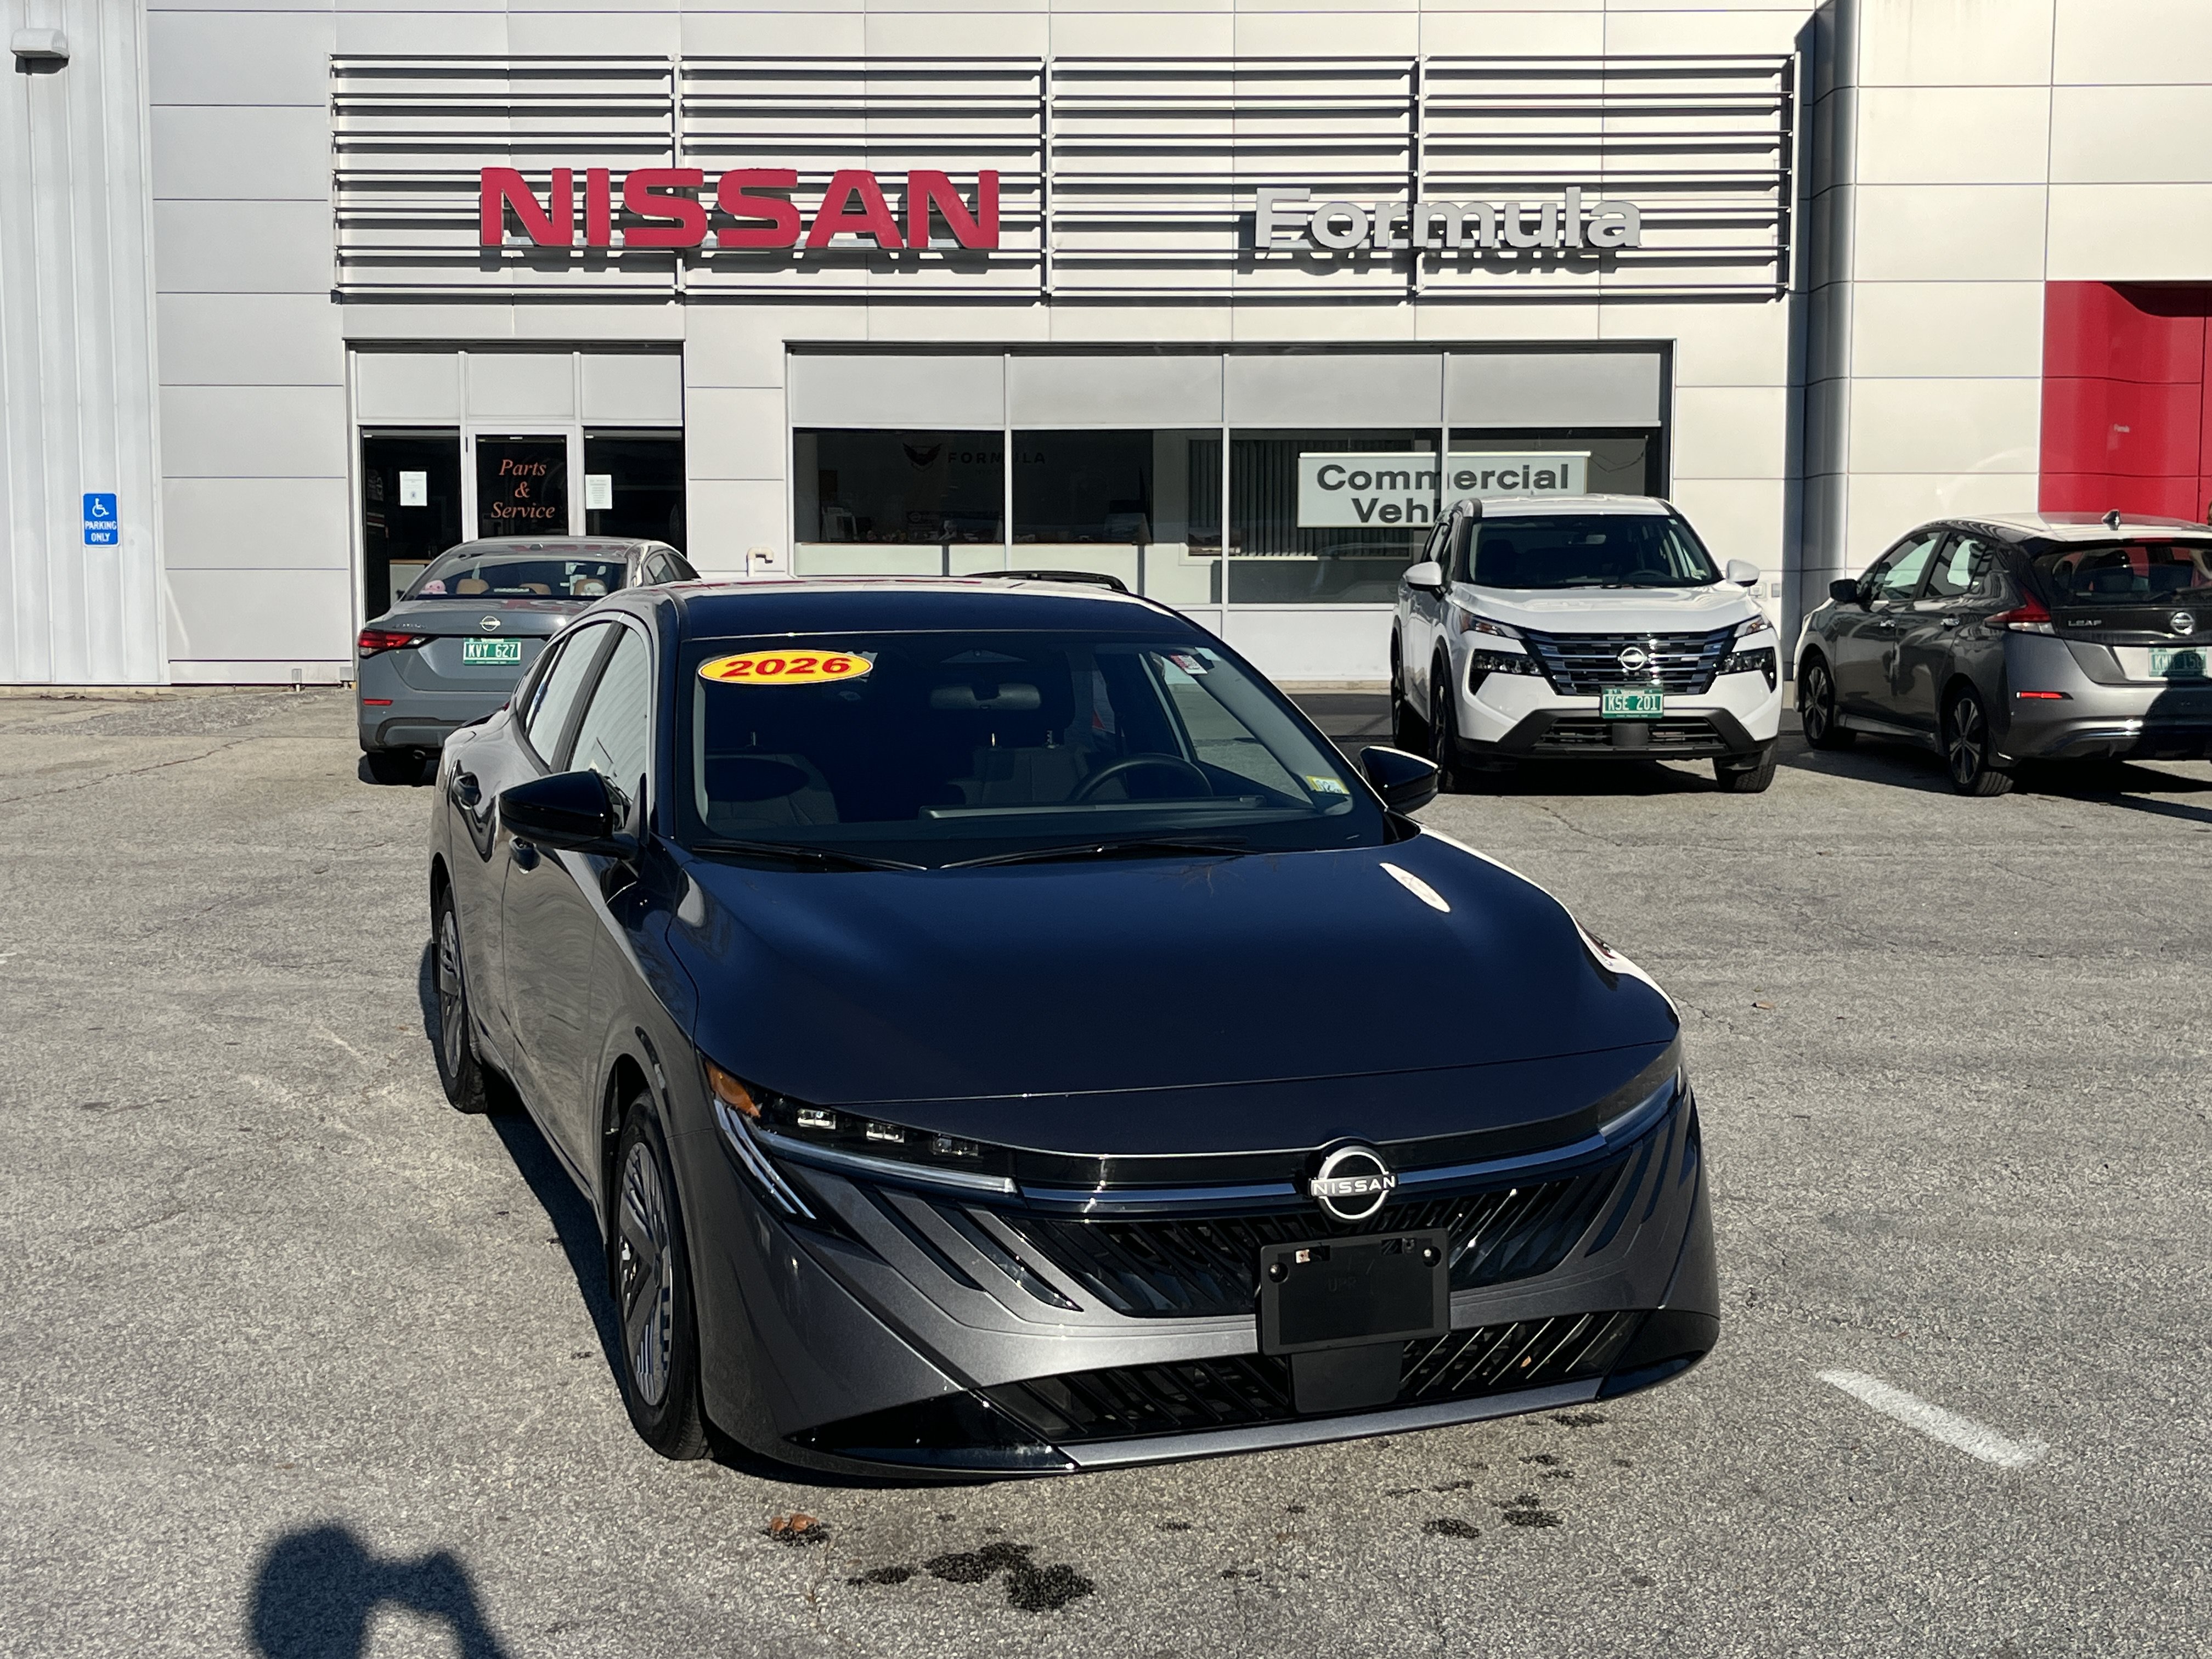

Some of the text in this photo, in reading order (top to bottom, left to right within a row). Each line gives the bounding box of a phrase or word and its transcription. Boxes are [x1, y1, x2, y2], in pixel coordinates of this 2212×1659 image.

[481, 167, 999, 249] NISSAN
[1255, 187, 1642, 249] Formula
[499, 459, 546, 476] Parts
[1317, 464, 1568, 491] Commercial
[515, 481, 531, 498] &
[491, 501, 555, 518] Service
[84, 521, 117, 530] PARKING
[91, 533, 111, 542] ONLY
[469, 644, 516, 658] KVY 627
[720, 658, 852, 678] 2026
[1608, 696, 1657, 710] KSE 201
[1313, 1176, 1395, 1195] NISSAN
